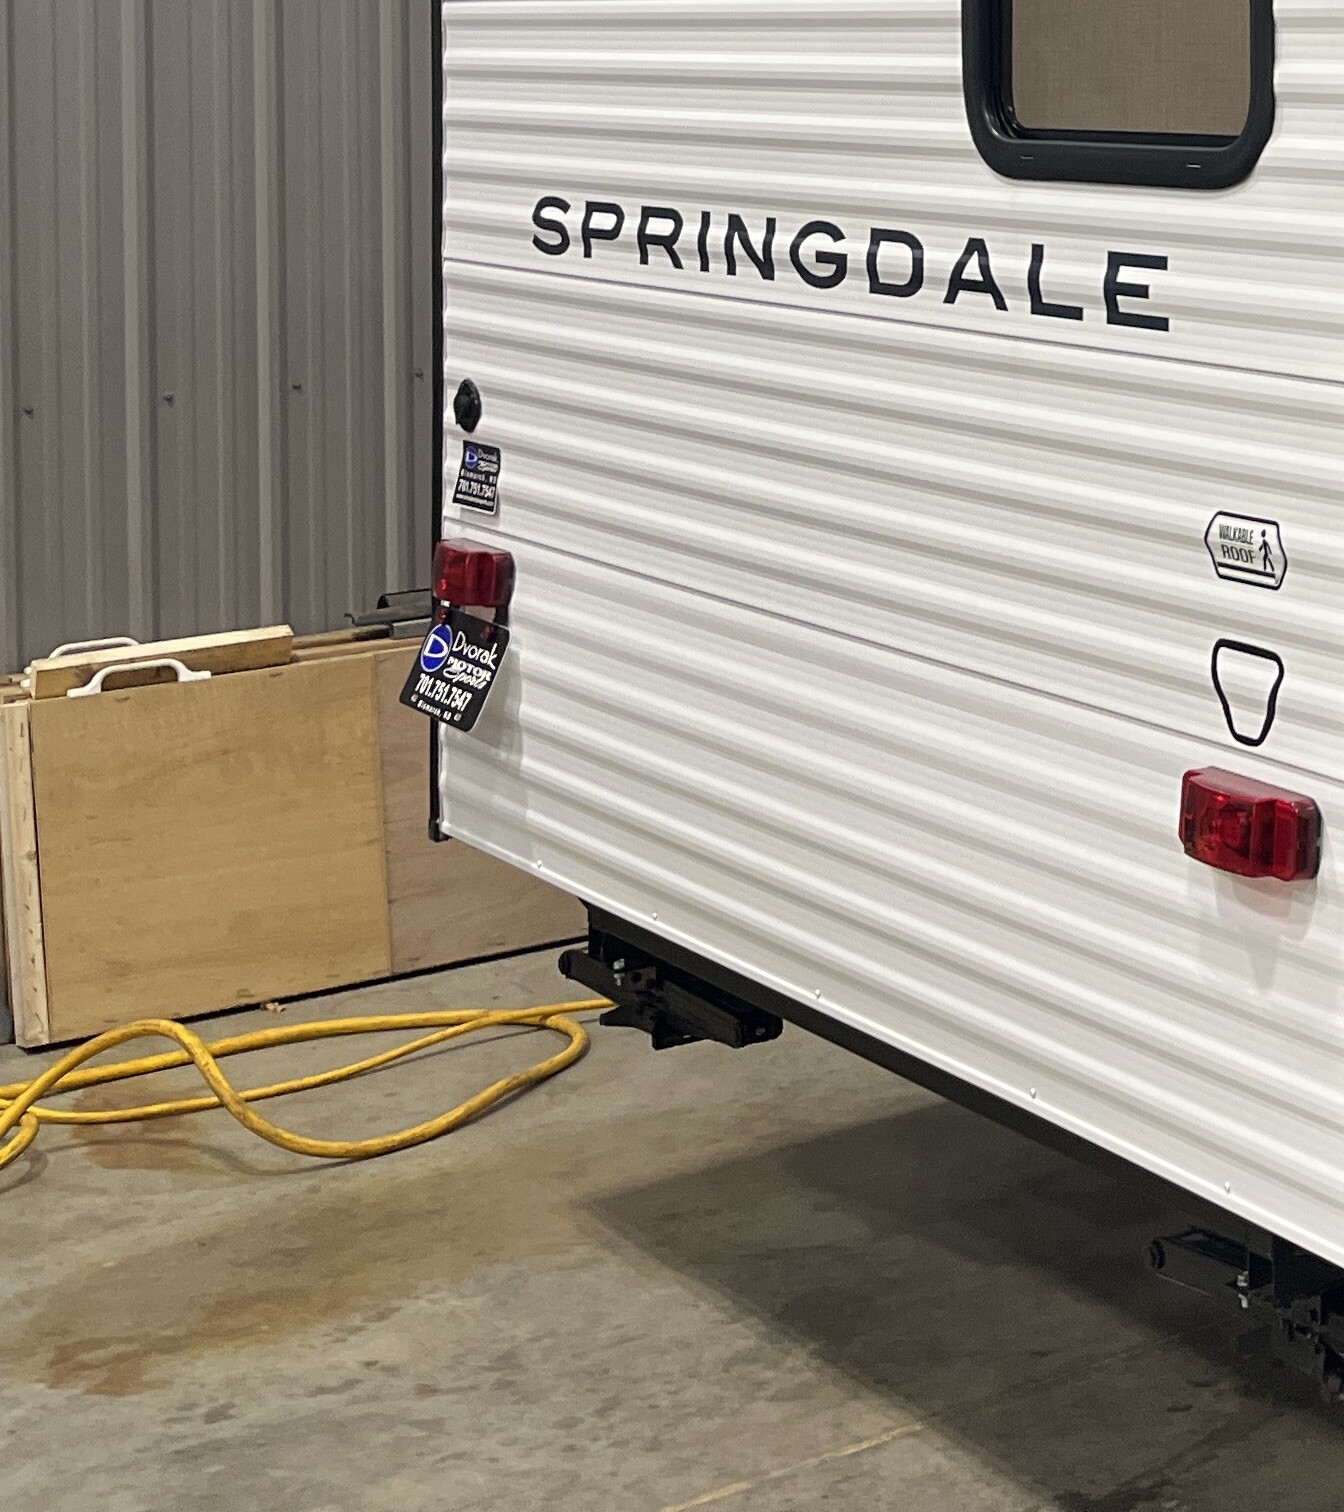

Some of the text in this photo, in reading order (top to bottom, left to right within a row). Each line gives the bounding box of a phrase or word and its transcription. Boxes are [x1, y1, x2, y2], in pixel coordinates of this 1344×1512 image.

[532, 196, 1170, 332] SPRINGDALE
[1219, 523, 1254, 546] WALKABLE
[1220, 544, 1256, 564] ROOF
[451, 630, 498, 670] Dvorak
[446, 656, 492, 682] MOTOR
[414, 672, 473, 712] 701.751.7547
